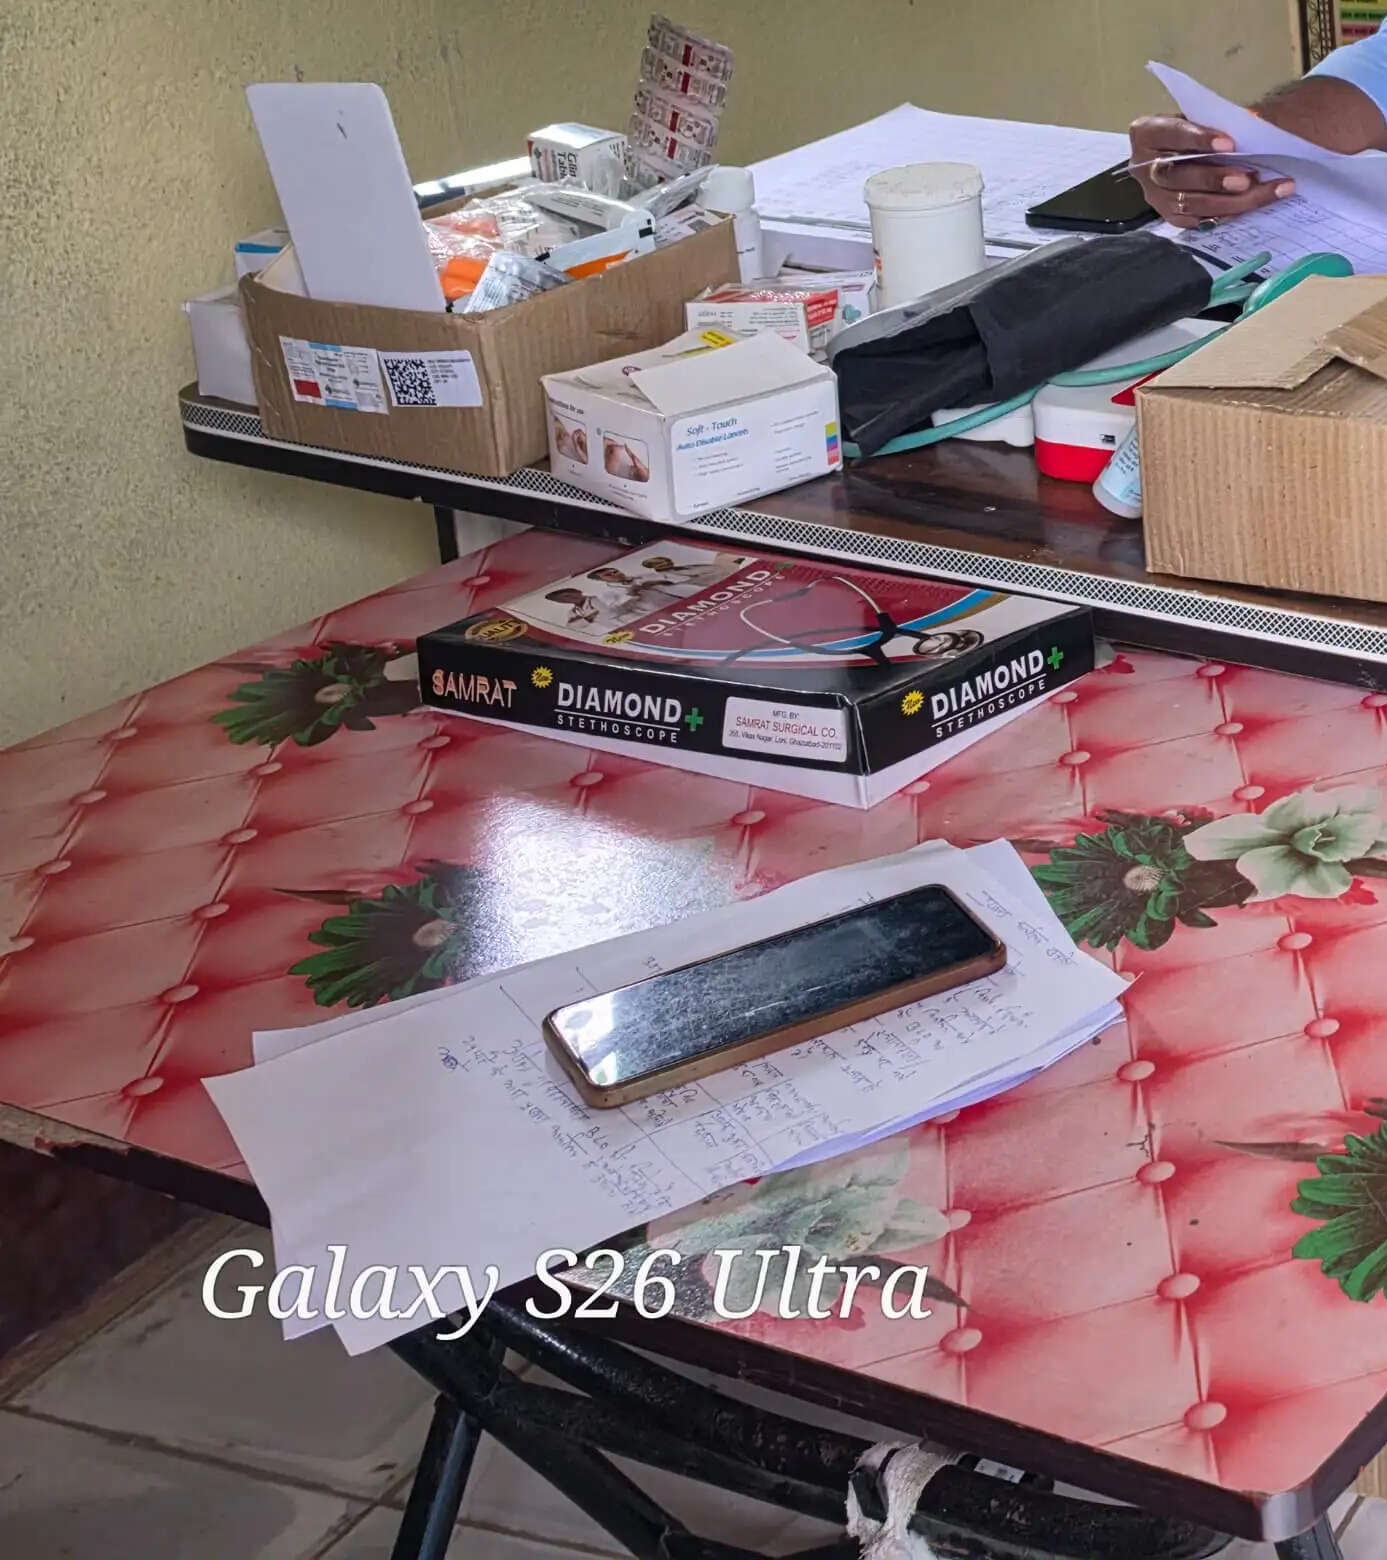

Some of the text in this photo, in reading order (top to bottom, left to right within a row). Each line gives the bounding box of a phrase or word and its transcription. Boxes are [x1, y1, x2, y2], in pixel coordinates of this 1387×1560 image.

[712, 417, 738, 431] Touch
[640, 570, 771, 634] DIAMOND
[432, 668, 518, 708] SAMRAT
[557, 682, 682, 724] DIAMOND
[931, 649, 1044, 720] DIAMOND
[557, 714, 678, 744] STETHOSCOPE
[736, 716, 838, 739] SAMRAT SURGICAL CO.
[936, 679, 1046, 738] STETHOSCOPE
